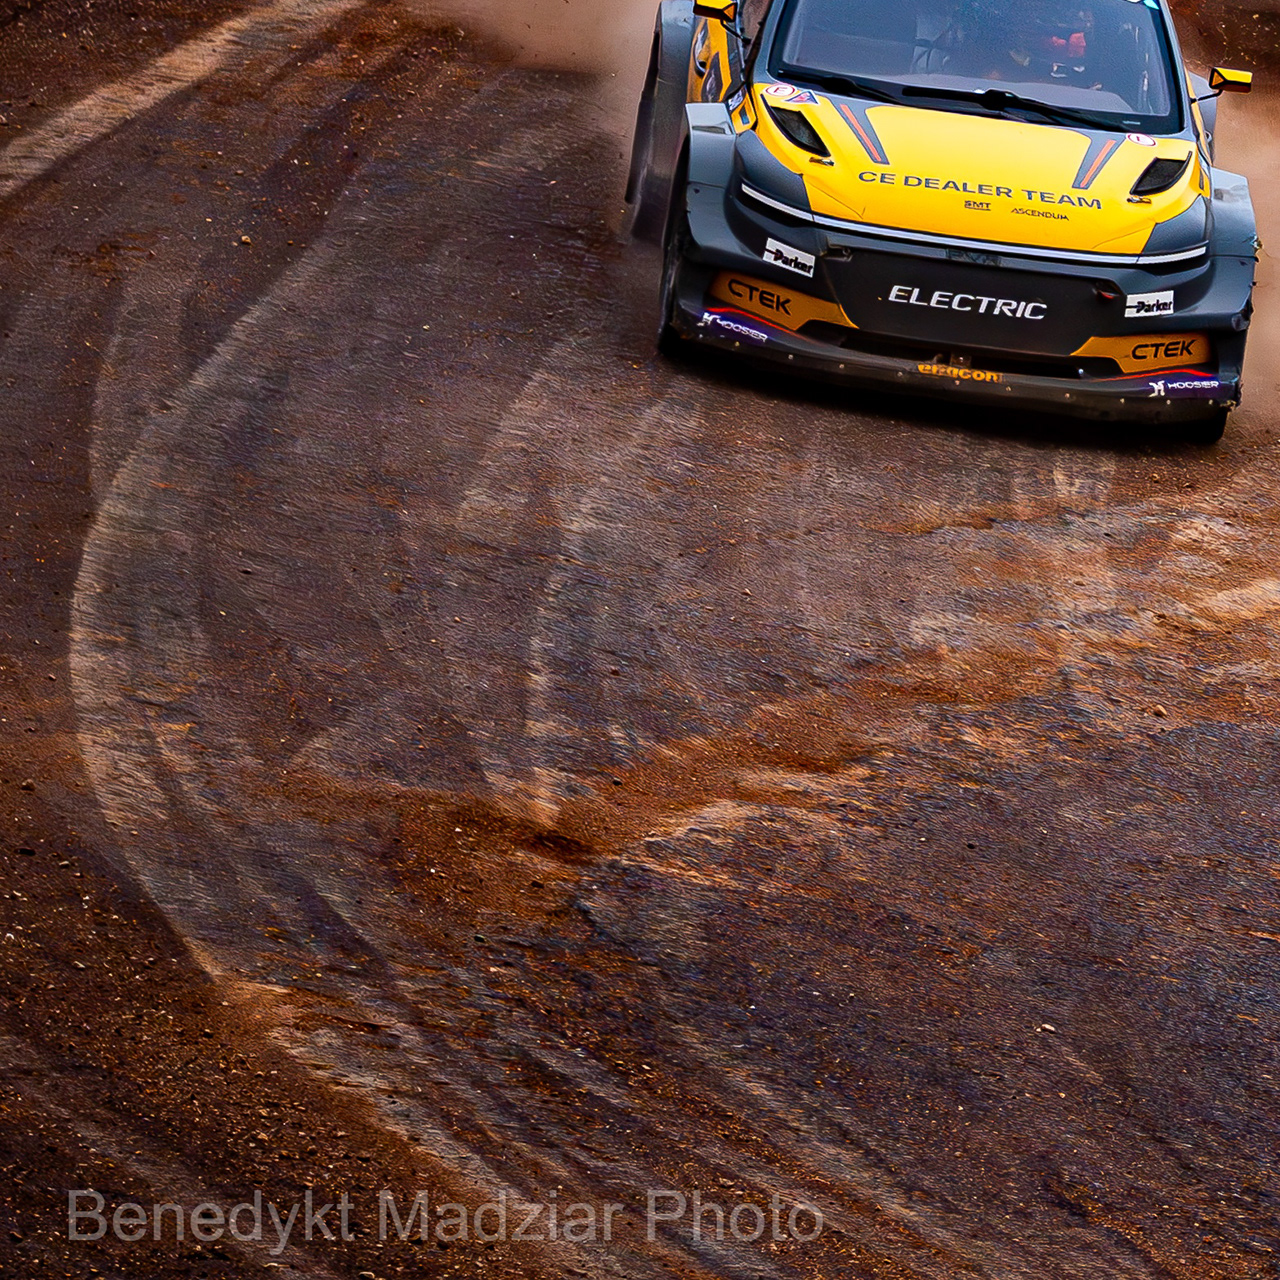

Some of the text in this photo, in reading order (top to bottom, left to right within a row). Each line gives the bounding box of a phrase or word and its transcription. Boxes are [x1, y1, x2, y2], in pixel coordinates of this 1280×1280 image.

[858, 171, 1102, 210] CE DEALER TEAM
[773, 249, 814, 275] Parker
[728, 278, 792, 317] CTEK
[888, 284, 1048, 320] ELECTRIC
[1135, 299, 1173, 314] Parker
[1131, 340, 1197, 360] CTEK
